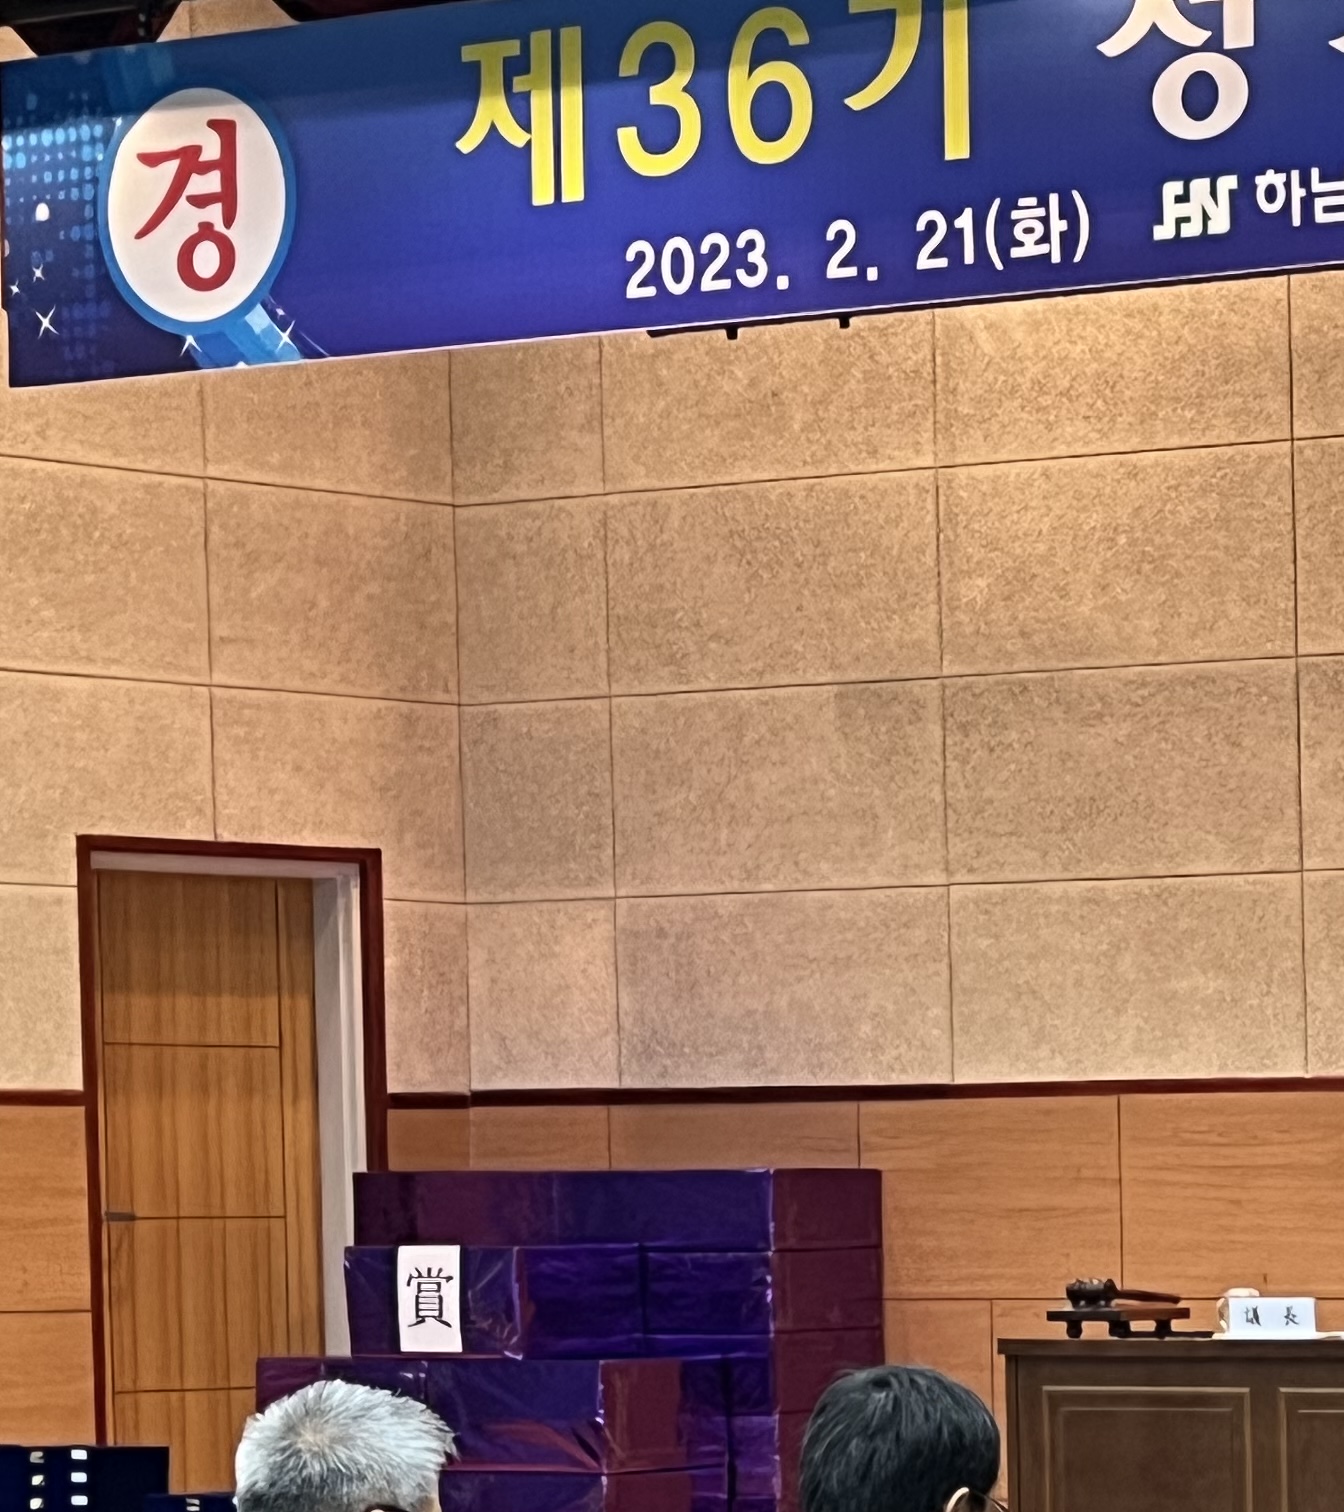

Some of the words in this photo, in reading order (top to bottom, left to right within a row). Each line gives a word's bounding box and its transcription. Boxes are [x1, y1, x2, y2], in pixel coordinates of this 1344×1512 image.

[454, 0, 970, 207] 제36기
[134, 117, 238, 293] 경
[624, 227, 791, 300] 2023.
[824, 218, 880, 283] 2.
[914, 188, 1091, 272] 21(화)
[406, 1266, 454, 1329] 賞
